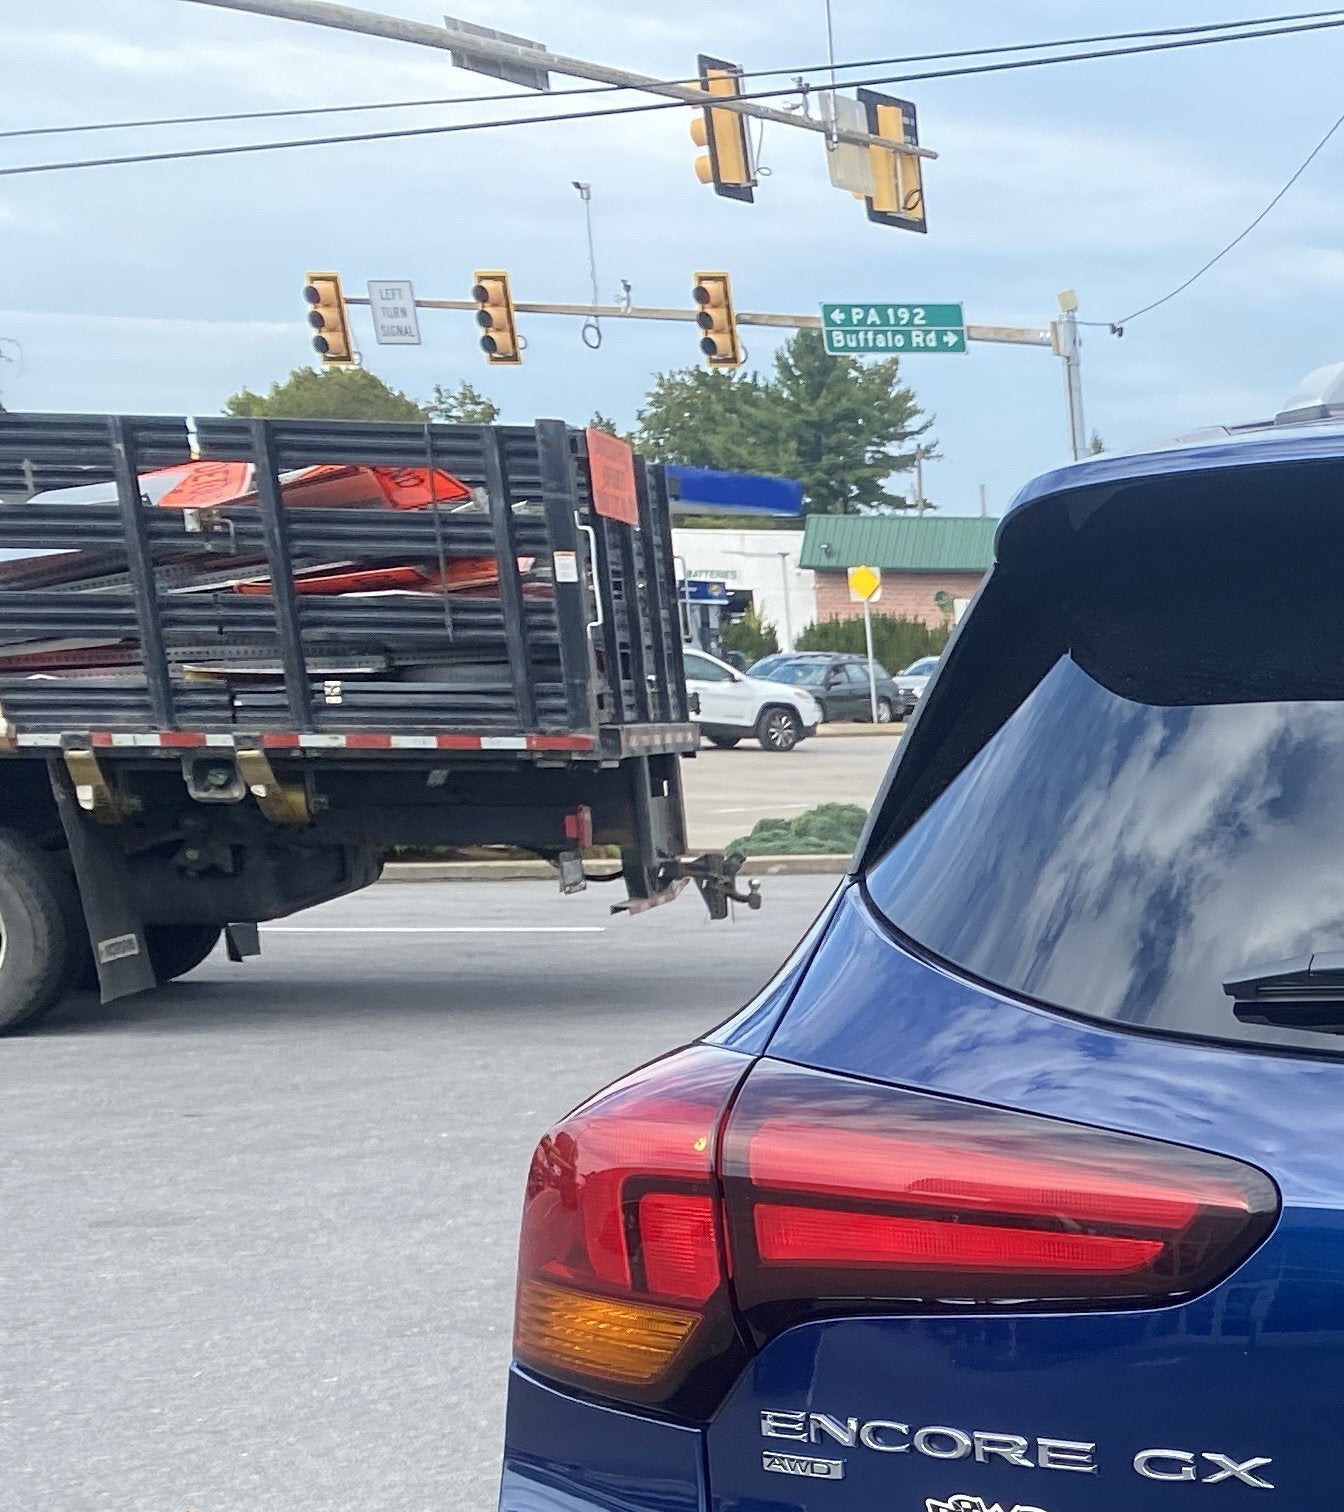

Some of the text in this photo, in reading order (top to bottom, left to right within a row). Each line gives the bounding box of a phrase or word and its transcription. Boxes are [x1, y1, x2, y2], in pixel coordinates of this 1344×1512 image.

[379, 288, 402, 300] LEFT
[381, 307, 408, 319] TURN
[851, 307, 927, 325] PA 192
[380, 325, 416, 337] SIGNAL
[832, 330, 937, 348] Buffalo Rd
[760, 1410, 1275, 1489] ENCORE GX
[766, 1457, 831, 1475] AWD
